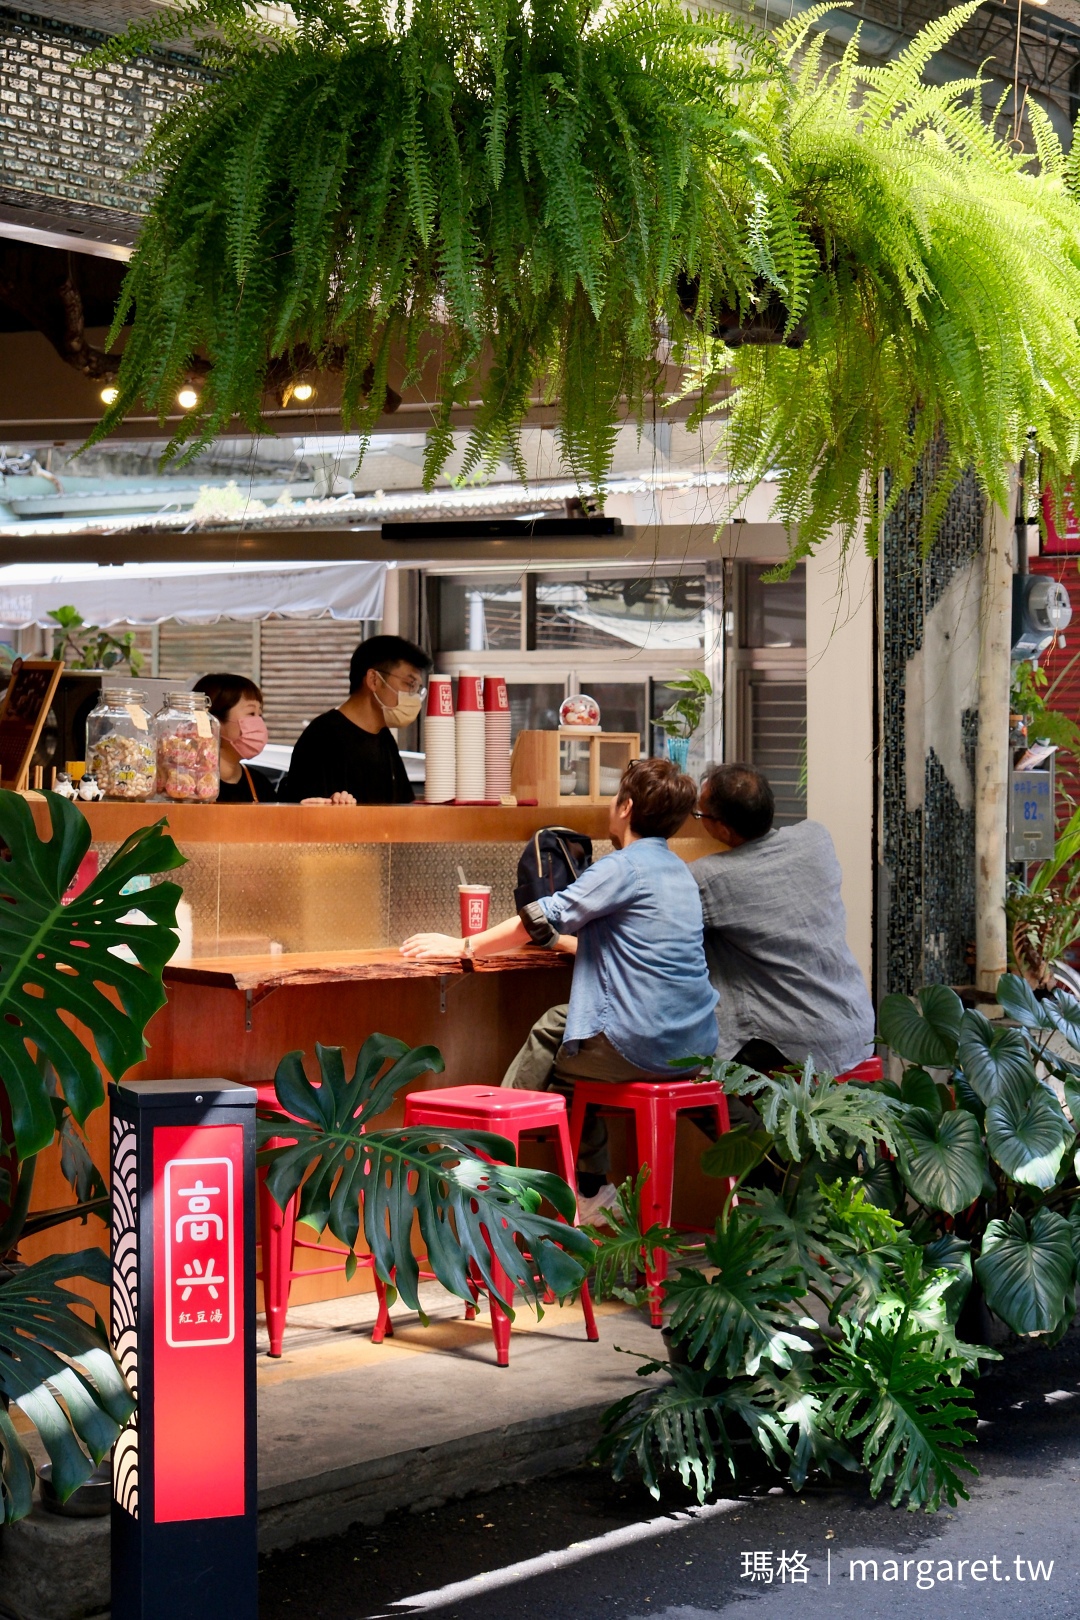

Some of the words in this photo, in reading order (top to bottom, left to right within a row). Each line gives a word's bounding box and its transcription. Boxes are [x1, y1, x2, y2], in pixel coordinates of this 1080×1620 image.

[175, 1179, 225, 1302] 高兴
[178, 1308, 223, 1325] 紅豆湯
